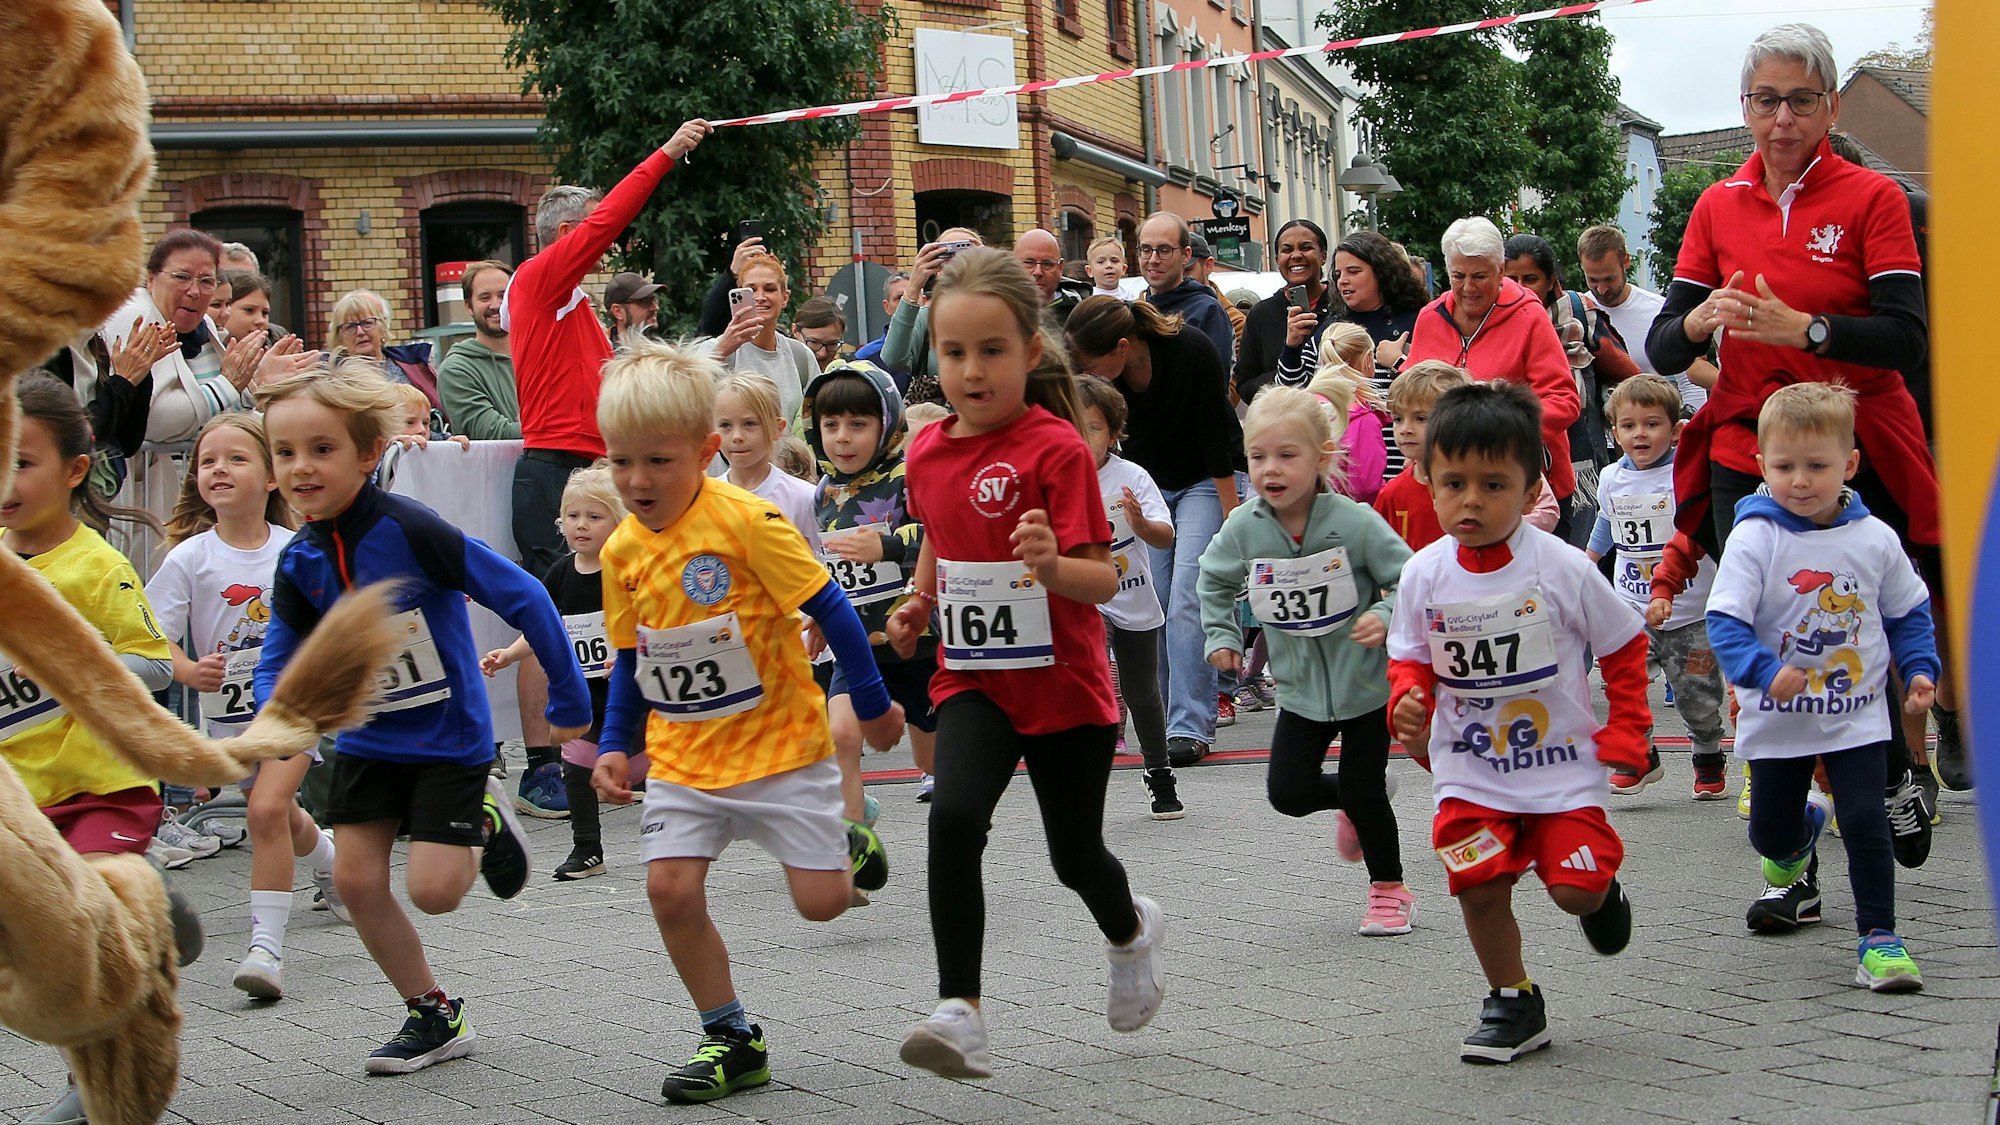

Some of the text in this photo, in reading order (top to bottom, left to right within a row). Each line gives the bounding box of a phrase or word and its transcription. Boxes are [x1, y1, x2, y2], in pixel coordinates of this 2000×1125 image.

[1206, 222, 1248, 236] monkeys
[977, 476, 1010, 503] SV
[1617, 519, 1653, 545] 31
[1270, 584, 1329, 622] 337
[1447, 610, 1499, 624] GVG-Citylauf
[943, 603, 1019, 647] 164
[1449, 624, 1483, 633] Bedburg
[574, 637, 608, 665] 06
[1444, 632, 1520, 678] 347
[651, 659, 727, 702] 123
[1475, 680, 1503, 688] Leandro
[1805, 665, 1854, 695] VG
[1462, 715, 1541, 756] GVG
[1451, 735, 1579, 775] mbini
